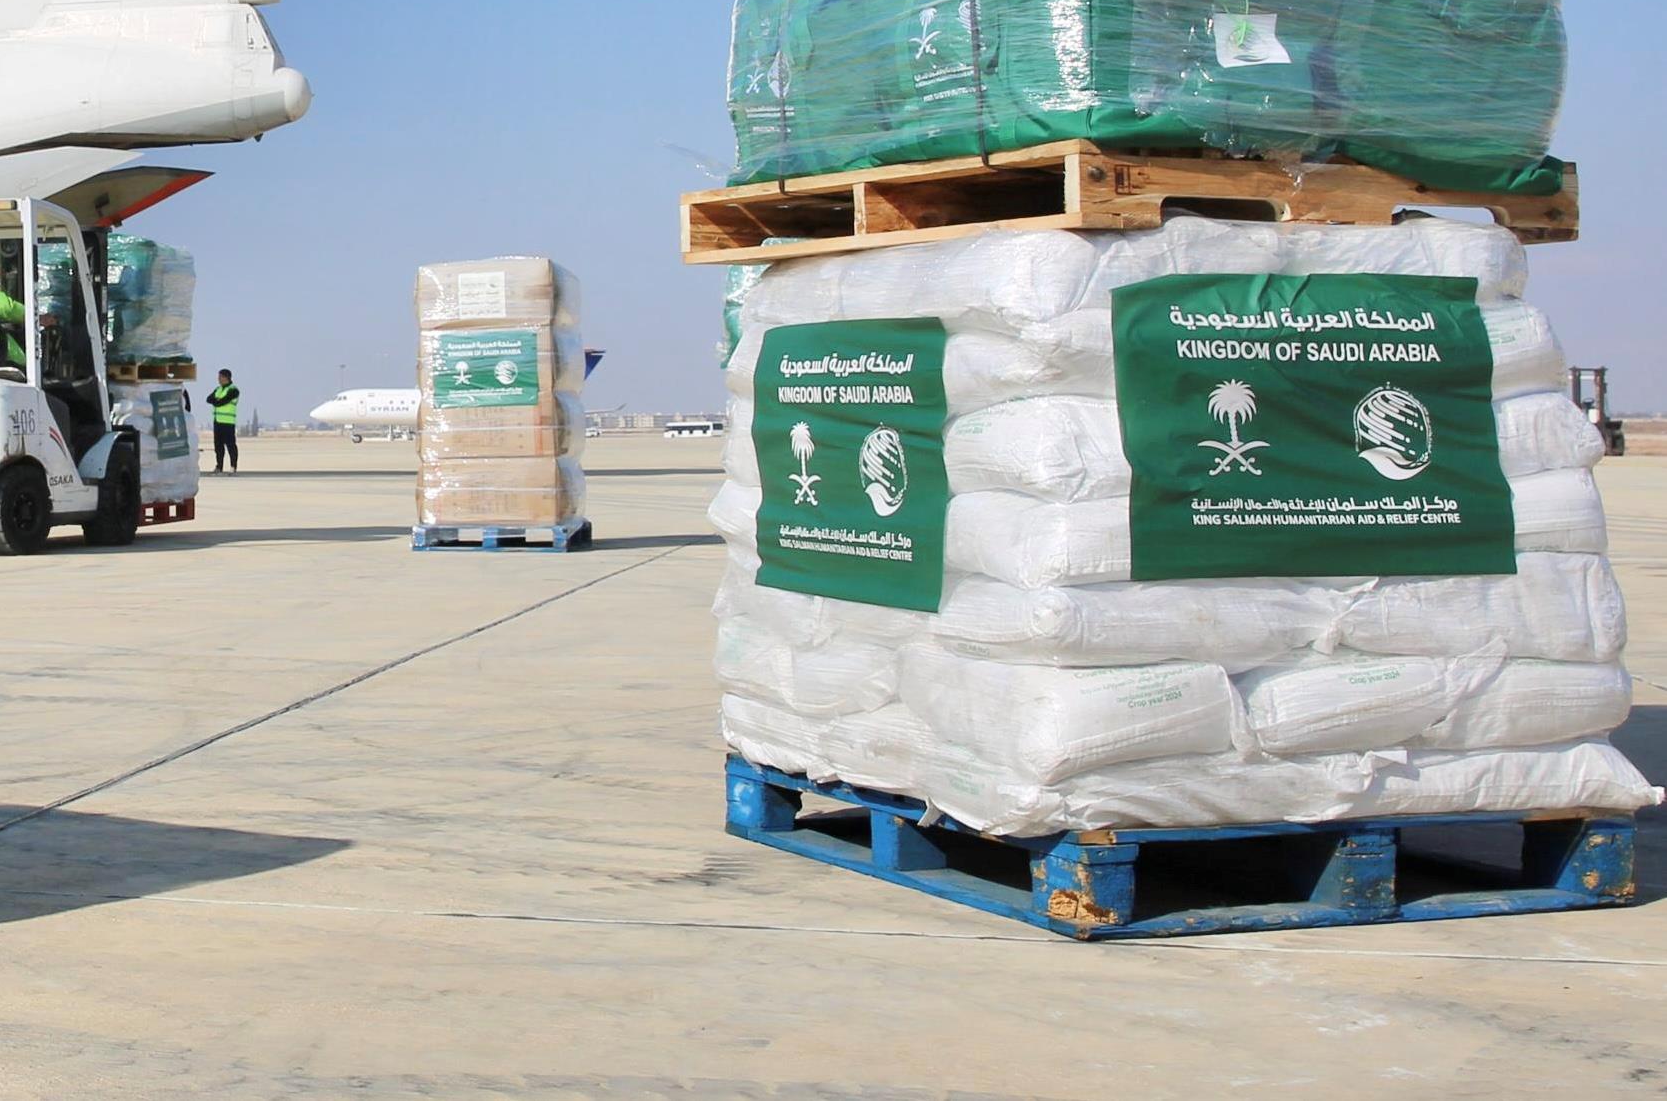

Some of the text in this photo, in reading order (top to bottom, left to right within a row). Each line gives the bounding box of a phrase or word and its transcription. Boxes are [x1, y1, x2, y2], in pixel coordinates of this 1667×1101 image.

[1169, 305, 1435, 332] المملكة العربية السعودية
[1176, 340, 1441, 362] KINGDOM OF SAUDI ARABIA
[780, 352, 914, 378] المملكة العربية السعودية
[778, 386, 914, 403] KINGDOM OF SAUDI ARABIA
[49, 474, 74, 487] OSAKA
[1326, 497, 1378, 512] سلمان
[1379, 496, 1421, 511] الملك
[1422, 496, 1458, 512] مركز
[1193, 513, 1461, 525] KING SALMAN HUMANITARIAN AID & RELIEF CENTRE
[889, 550, 912, 561] CENTRE
[1128, 699, 1147, 709] Crop
[1165, 691, 1182, 700] 2024
